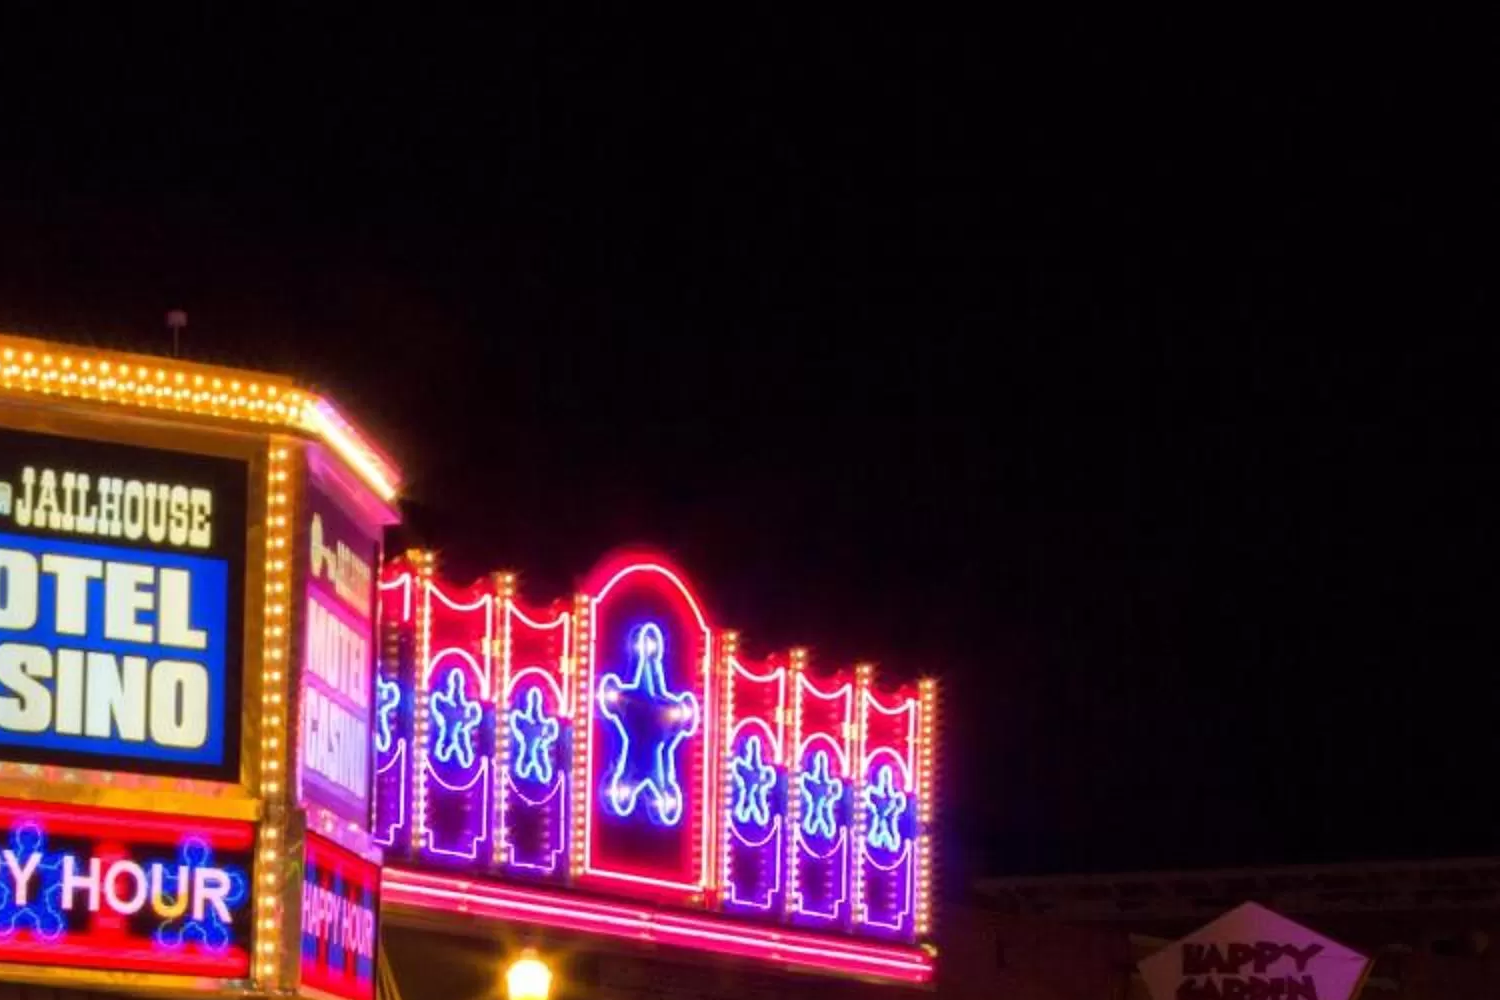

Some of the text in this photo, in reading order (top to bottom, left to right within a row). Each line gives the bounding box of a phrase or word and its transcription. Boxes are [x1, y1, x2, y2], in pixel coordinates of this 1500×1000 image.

[15, 466, 212, 549] JAILHOUSE
[61, 855, 233, 924] HOUR
[301, 880, 374, 959] HAPPY HOUR
[1181, 942, 1325, 976] HAPPY
